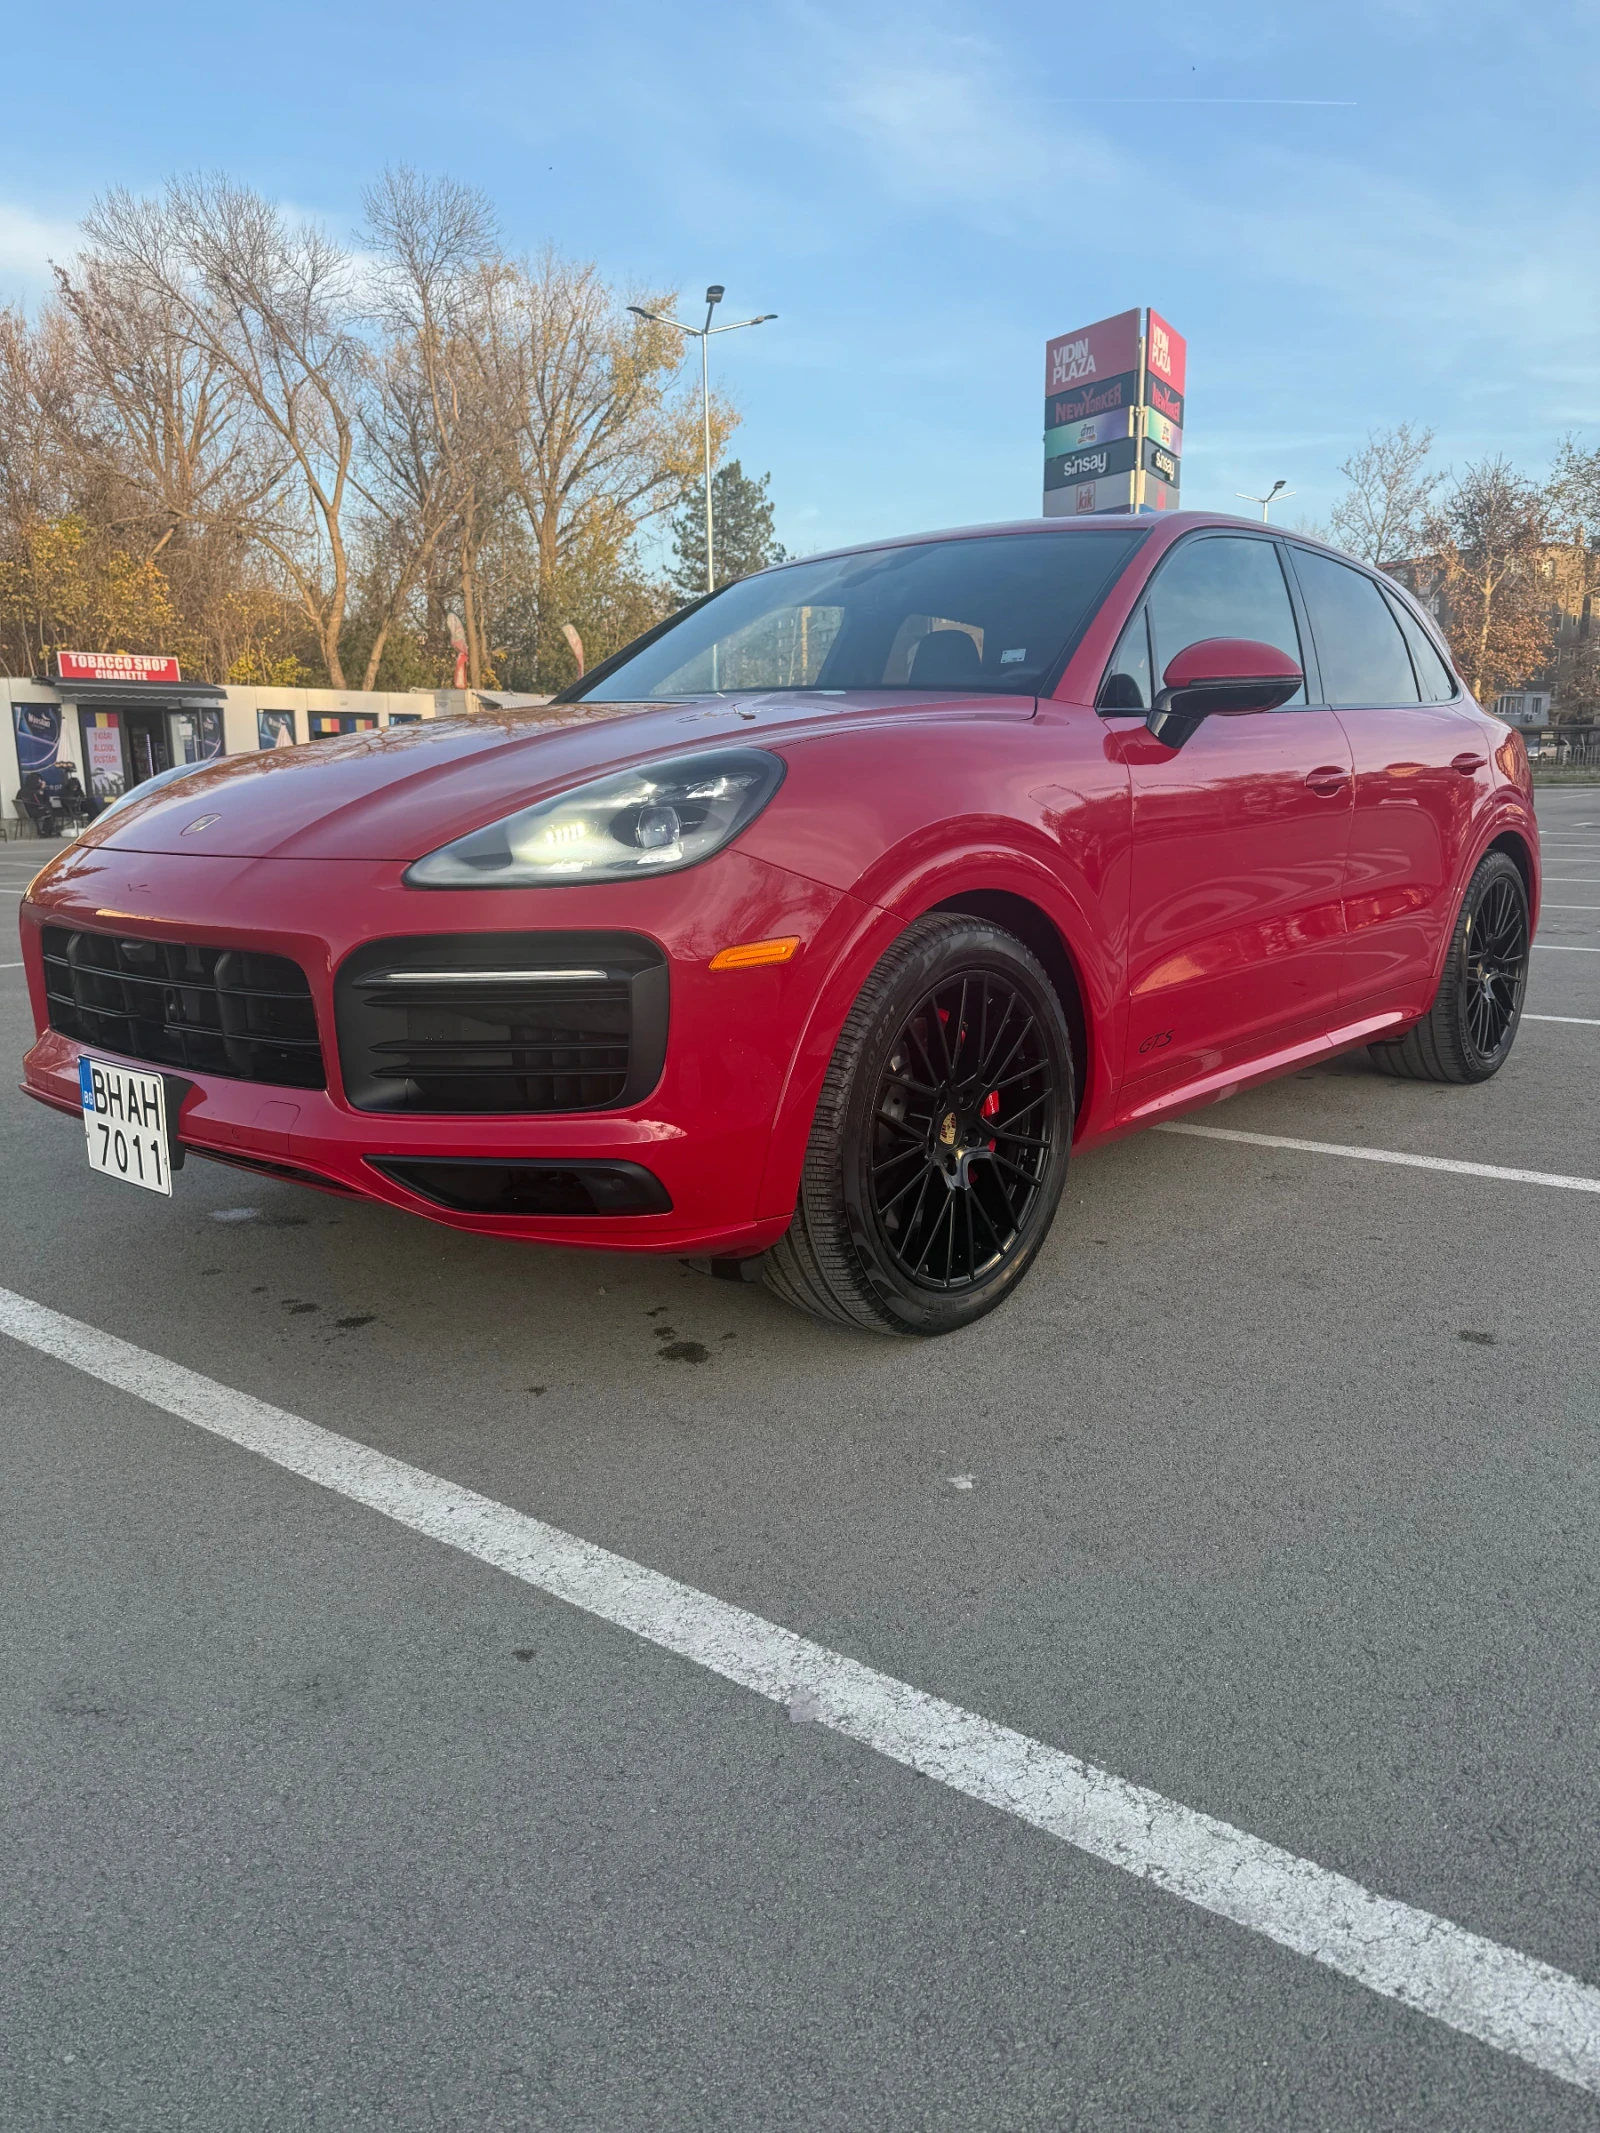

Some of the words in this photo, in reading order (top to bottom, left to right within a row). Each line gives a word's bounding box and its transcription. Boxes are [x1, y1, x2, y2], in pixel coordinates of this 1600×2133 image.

[1153, 324, 1170, 353] VIDIN
[1053, 338, 1089, 366] VIDIN
[1152, 347, 1171, 376] PLAZA
[1053, 355, 1097, 385] PLAZA
[1080, 423, 1095, 437] dm
[1064, 452, 1107, 476] sinsay
[1155, 449, 1175, 480] sinsay
[69, 655, 132, 671] TOBACCO
[134, 658, 168, 672] SHOP
[95, 670, 148, 681] CIGARETTE
[1139, 1029, 1175, 1054] GTS
[84, 1091, 93, 1105] BG
[98, 1123, 162, 1185] 7011
